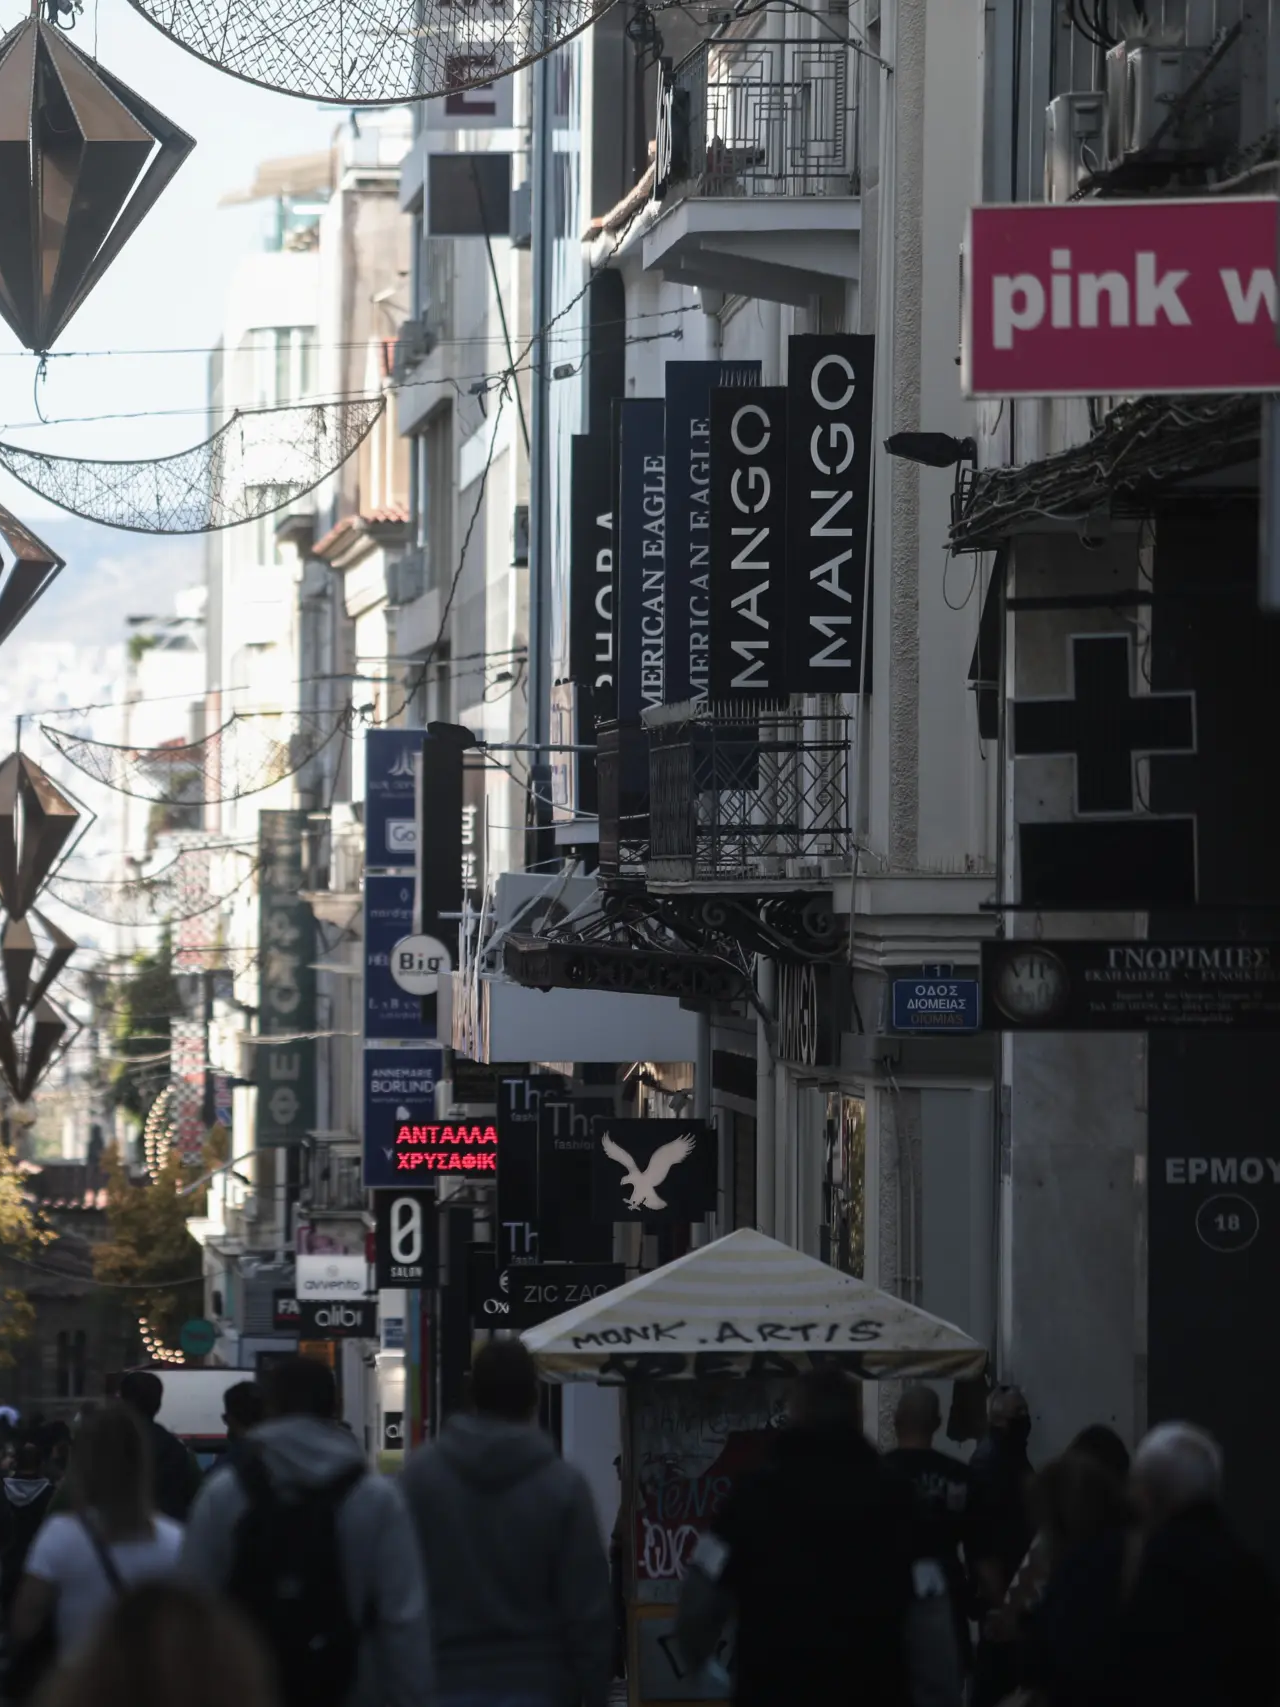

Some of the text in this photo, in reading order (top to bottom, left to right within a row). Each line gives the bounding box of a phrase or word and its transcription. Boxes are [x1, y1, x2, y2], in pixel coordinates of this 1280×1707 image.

[992, 249, 1191, 350] pink
[809, 353, 856, 668] MANGO
[730, 403, 771, 689] MANGO
[641, 455, 666, 712] MERICAN EAGLE
[689, 543, 711, 706] MERICAN
[932, 965, 941, 977] 1
[914, 985, 959, 996] ΟΔΟΣ
[906, 998, 967, 1010] ΔΙΟΜΕΙΑΣ
[371, 1068, 433, 1078] ANNEMARIE
[501, 1079, 542, 1110] Th
[395, 1125, 499, 1145] ΑΝΤΑΛΛΑ
[396, 1152, 497, 1171] ΧΡΥΣΑΦΙΚ
[523, 1284, 558, 1303] ZIC
[571, 1321, 686, 1350] MONK
